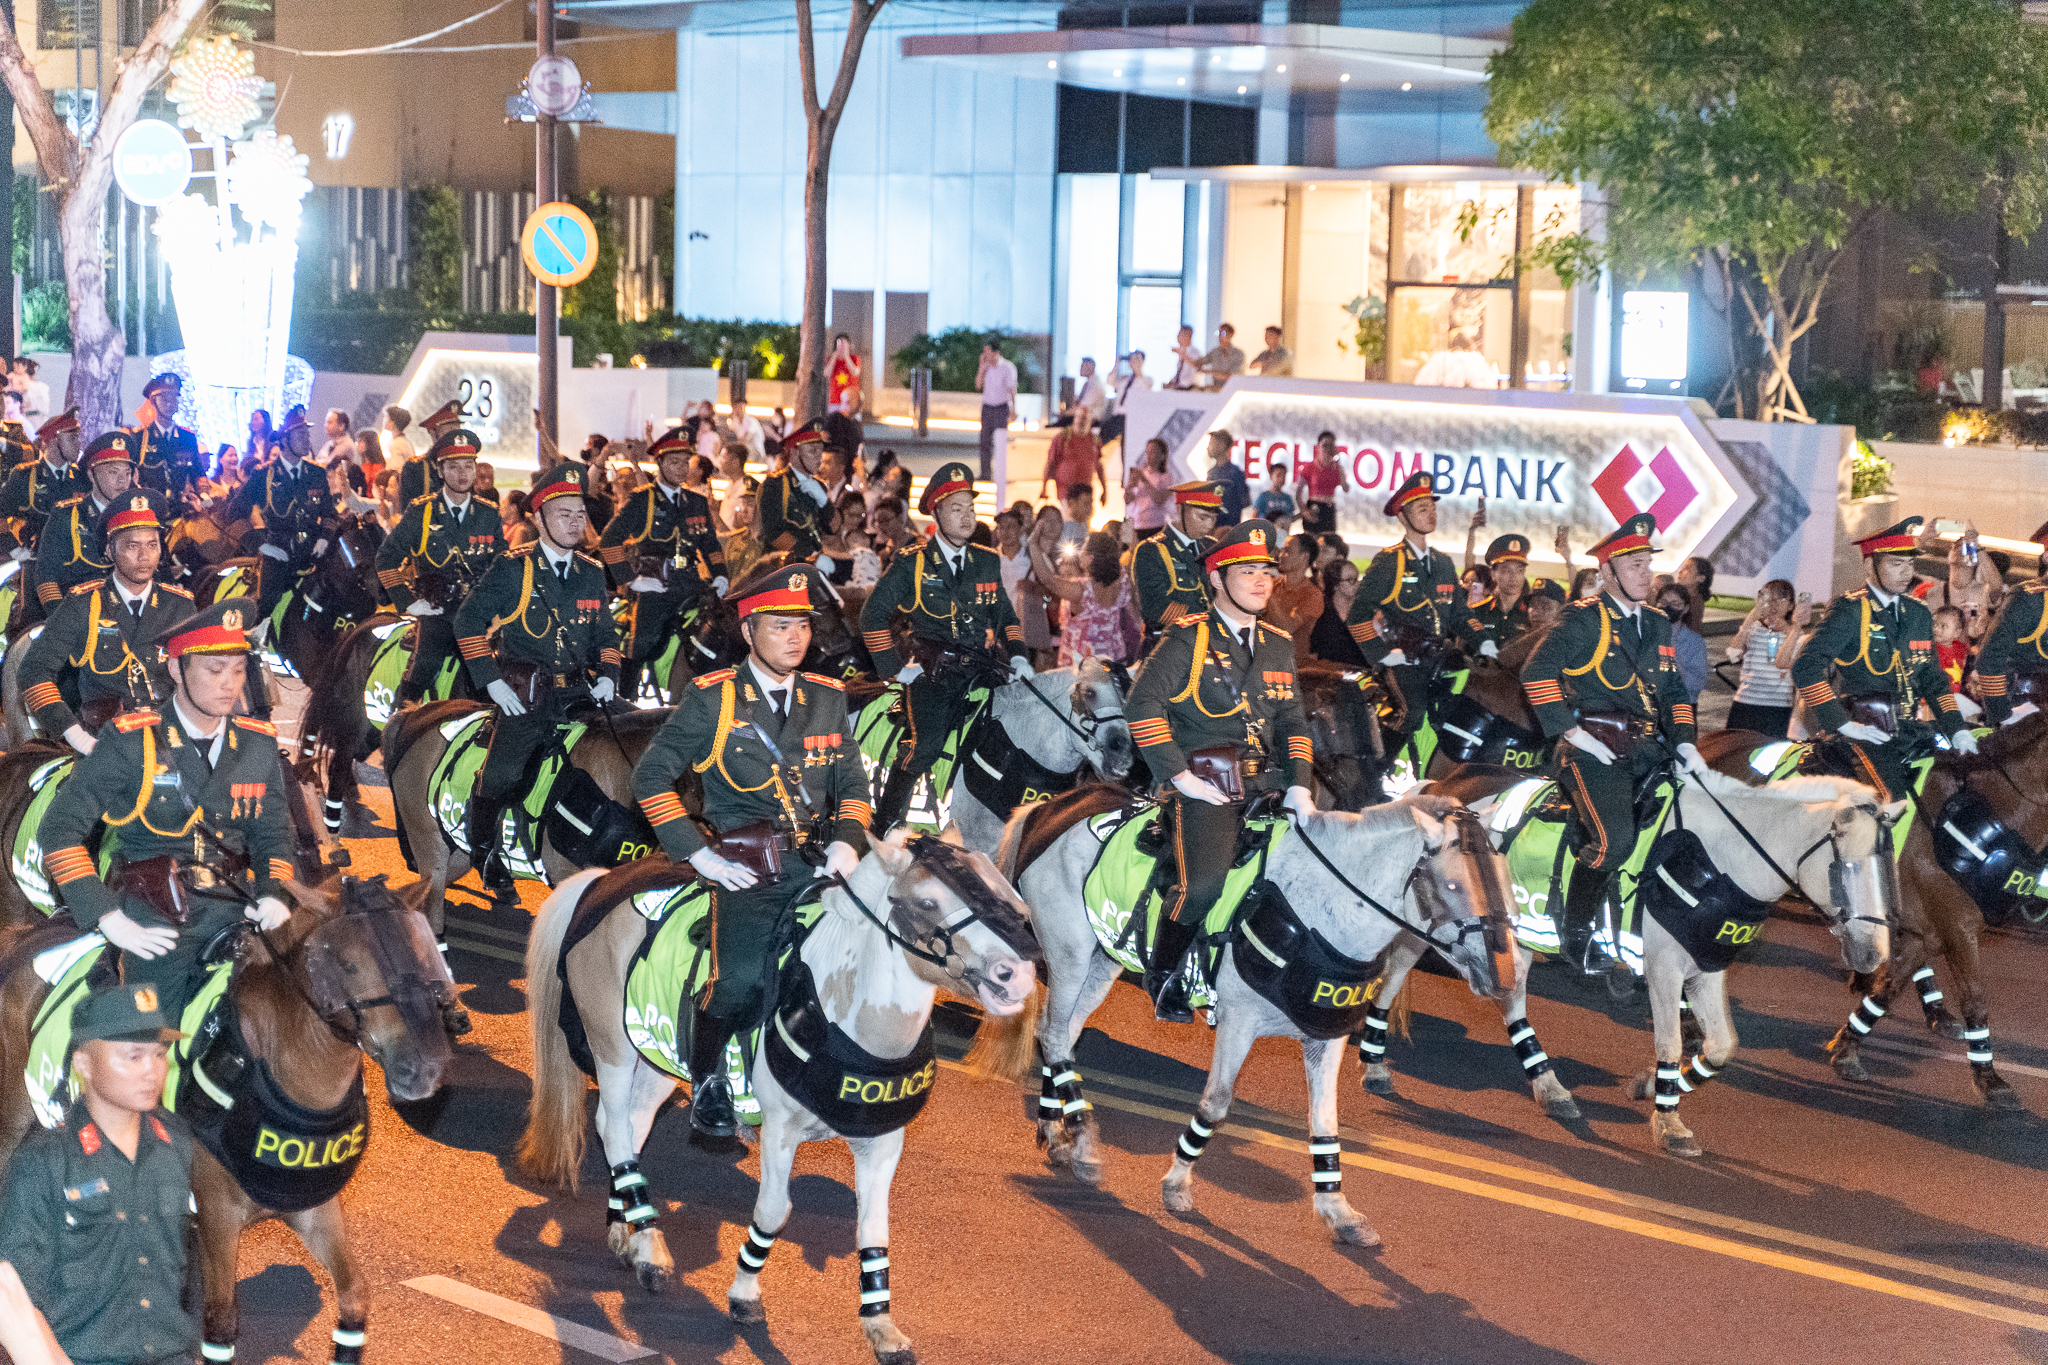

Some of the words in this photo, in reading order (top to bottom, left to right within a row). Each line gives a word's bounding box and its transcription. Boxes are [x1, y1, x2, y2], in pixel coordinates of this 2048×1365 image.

[459, 379, 492, 417] 23
[1313, 978, 1382, 1006] POLIC
[840, 1060, 935, 1103] POLICE
[255, 1124, 364, 1167] POLICE
